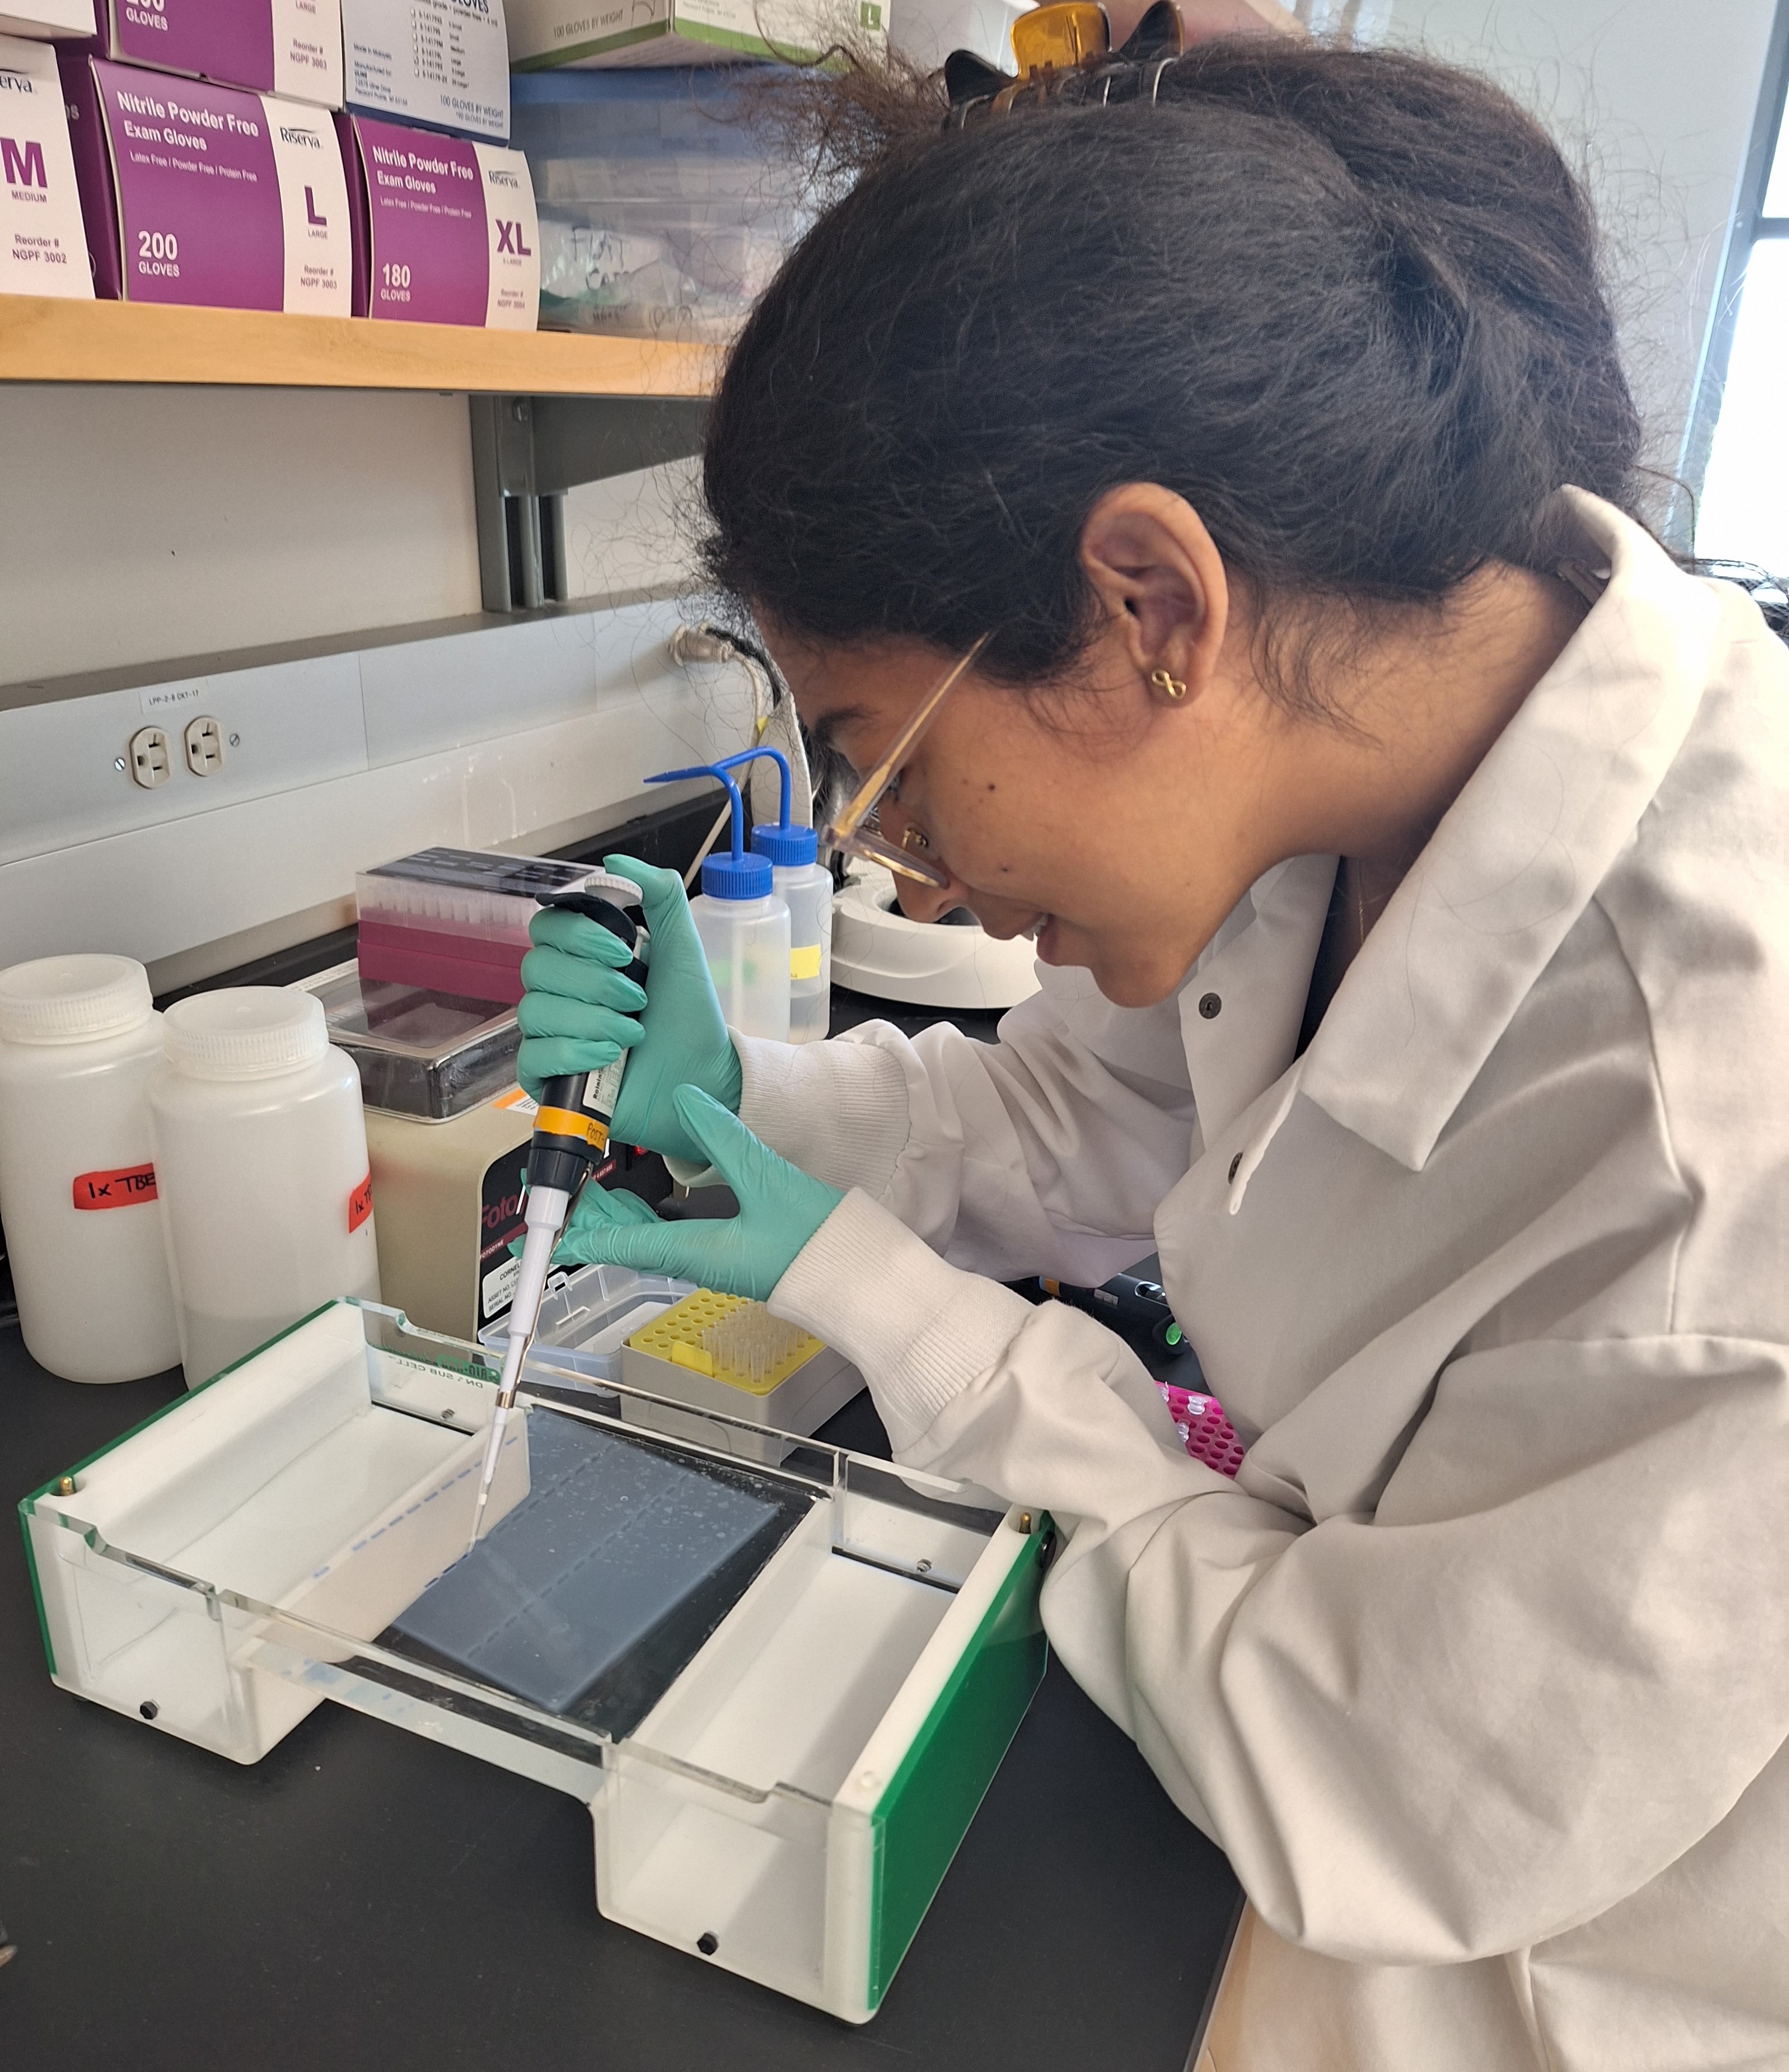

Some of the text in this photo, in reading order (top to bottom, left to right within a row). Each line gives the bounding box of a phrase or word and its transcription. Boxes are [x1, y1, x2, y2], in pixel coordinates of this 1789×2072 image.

[295, 0, 316, 14] LARGE
[126, 7, 168, 31] GLOVES
[554, 9, 623, 38] 100 GLOVES BY WEIGHT
[293, 39, 317, 53] Reorder
[290, 51, 327, 70] NGPF 3003
[117, 91, 259, 137] Nitrile Powder Free
[440, 95, 503, 118] 100 GLOVES BY WEIGHT
[124, 119, 207, 151] Exam Gloves
[279, 126, 321, 150] Riserva
[0, 137, 48, 188] M
[129, 150, 150, 164] Latex
[151, 153, 167, 167] Free
[172, 157, 198, 172] Powder
[198, 161, 214, 175] Free
[219, 165, 241, 179] Protein
[242, 170, 257, 182] Free
[372, 146, 474, 181] Nitrile Powder Free
[377, 170, 436, 194] Exam Gloves
[11, 191, 47, 203] MEDIUM
[305, 185, 327, 226] L
[381, 196, 394, 206] Latex
[395, 198, 406, 209] Free
[410, 200, 429, 212] Powder
[429, 203, 440, 214] Free
[461, 208, 472, 219] Free
[15, 234, 51, 247] Reorder
[139, 230, 178, 261] 200
[308, 229, 327, 239] LARGE
[496, 219, 531, 257] XL
[12, 248, 67, 263] NGPF 3002
[139, 260, 180, 278] GLOVES
[304, 265, 328, 275] Reorder
[382, 263, 410, 288] 180
[301, 277, 337, 289] NGPF 3003
[381, 288, 410, 302] GLOVES
[115, 1171, 156, 1193] TBE
